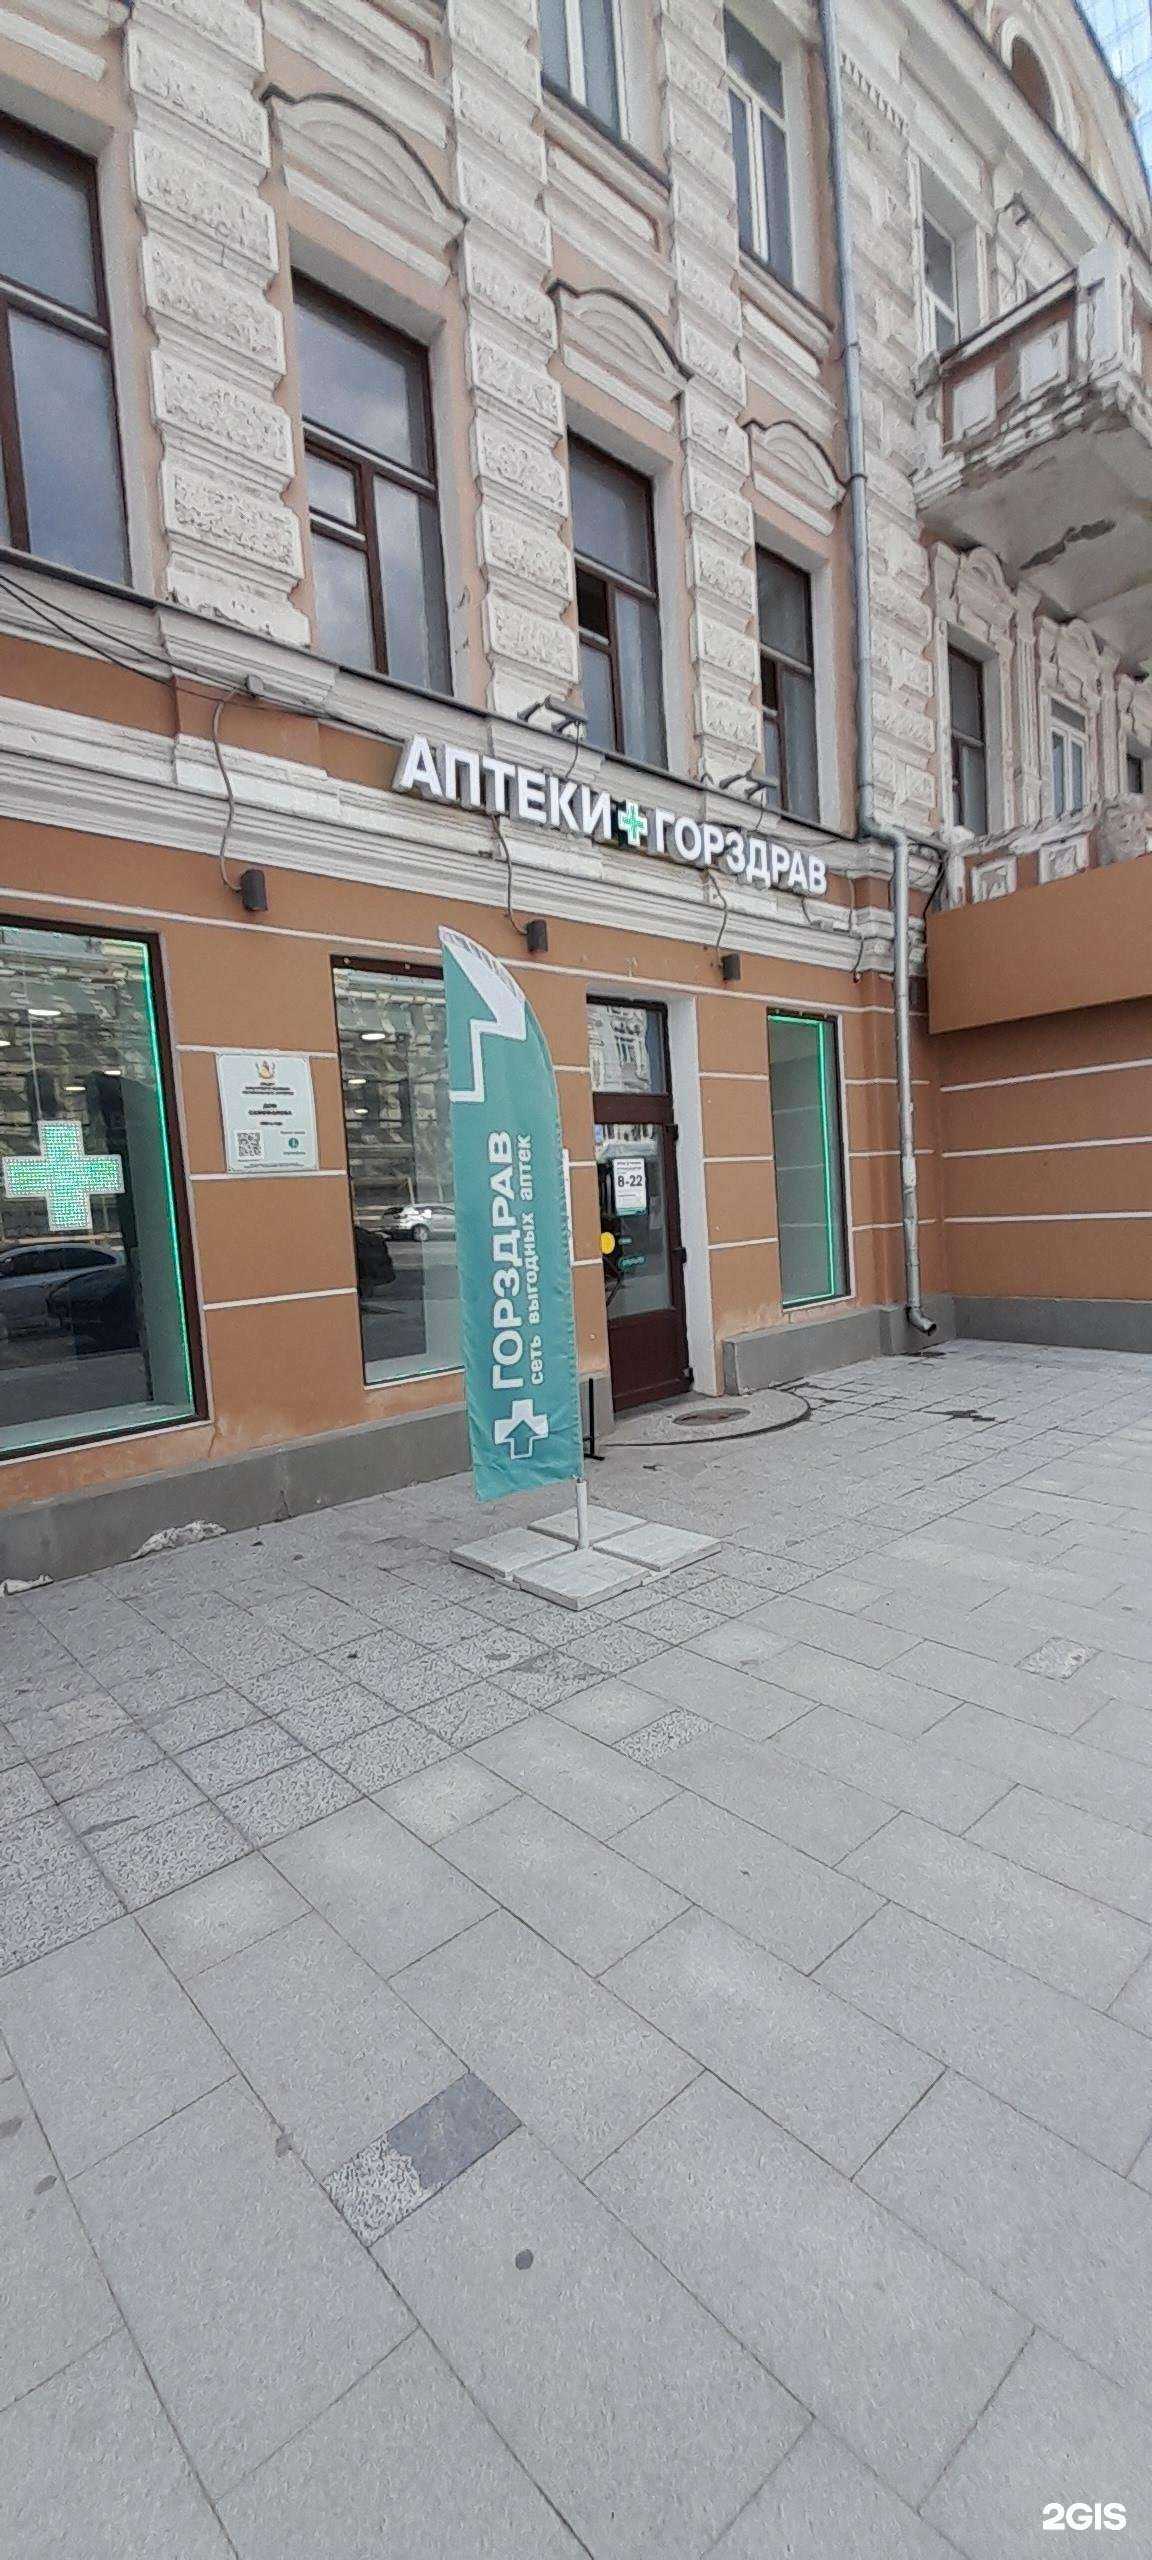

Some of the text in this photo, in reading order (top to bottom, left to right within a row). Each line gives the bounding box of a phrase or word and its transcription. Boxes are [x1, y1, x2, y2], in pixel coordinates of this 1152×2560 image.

[396, 733, 830, 897] АПТЕКИ ГОРЗДРАВ
[488, 1130, 525, 1390] ГОРЗДРАВ
[515, 1134, 545, 1386] сеть выгодных аптек
[617, 1174, 643, 1188] 8-22
